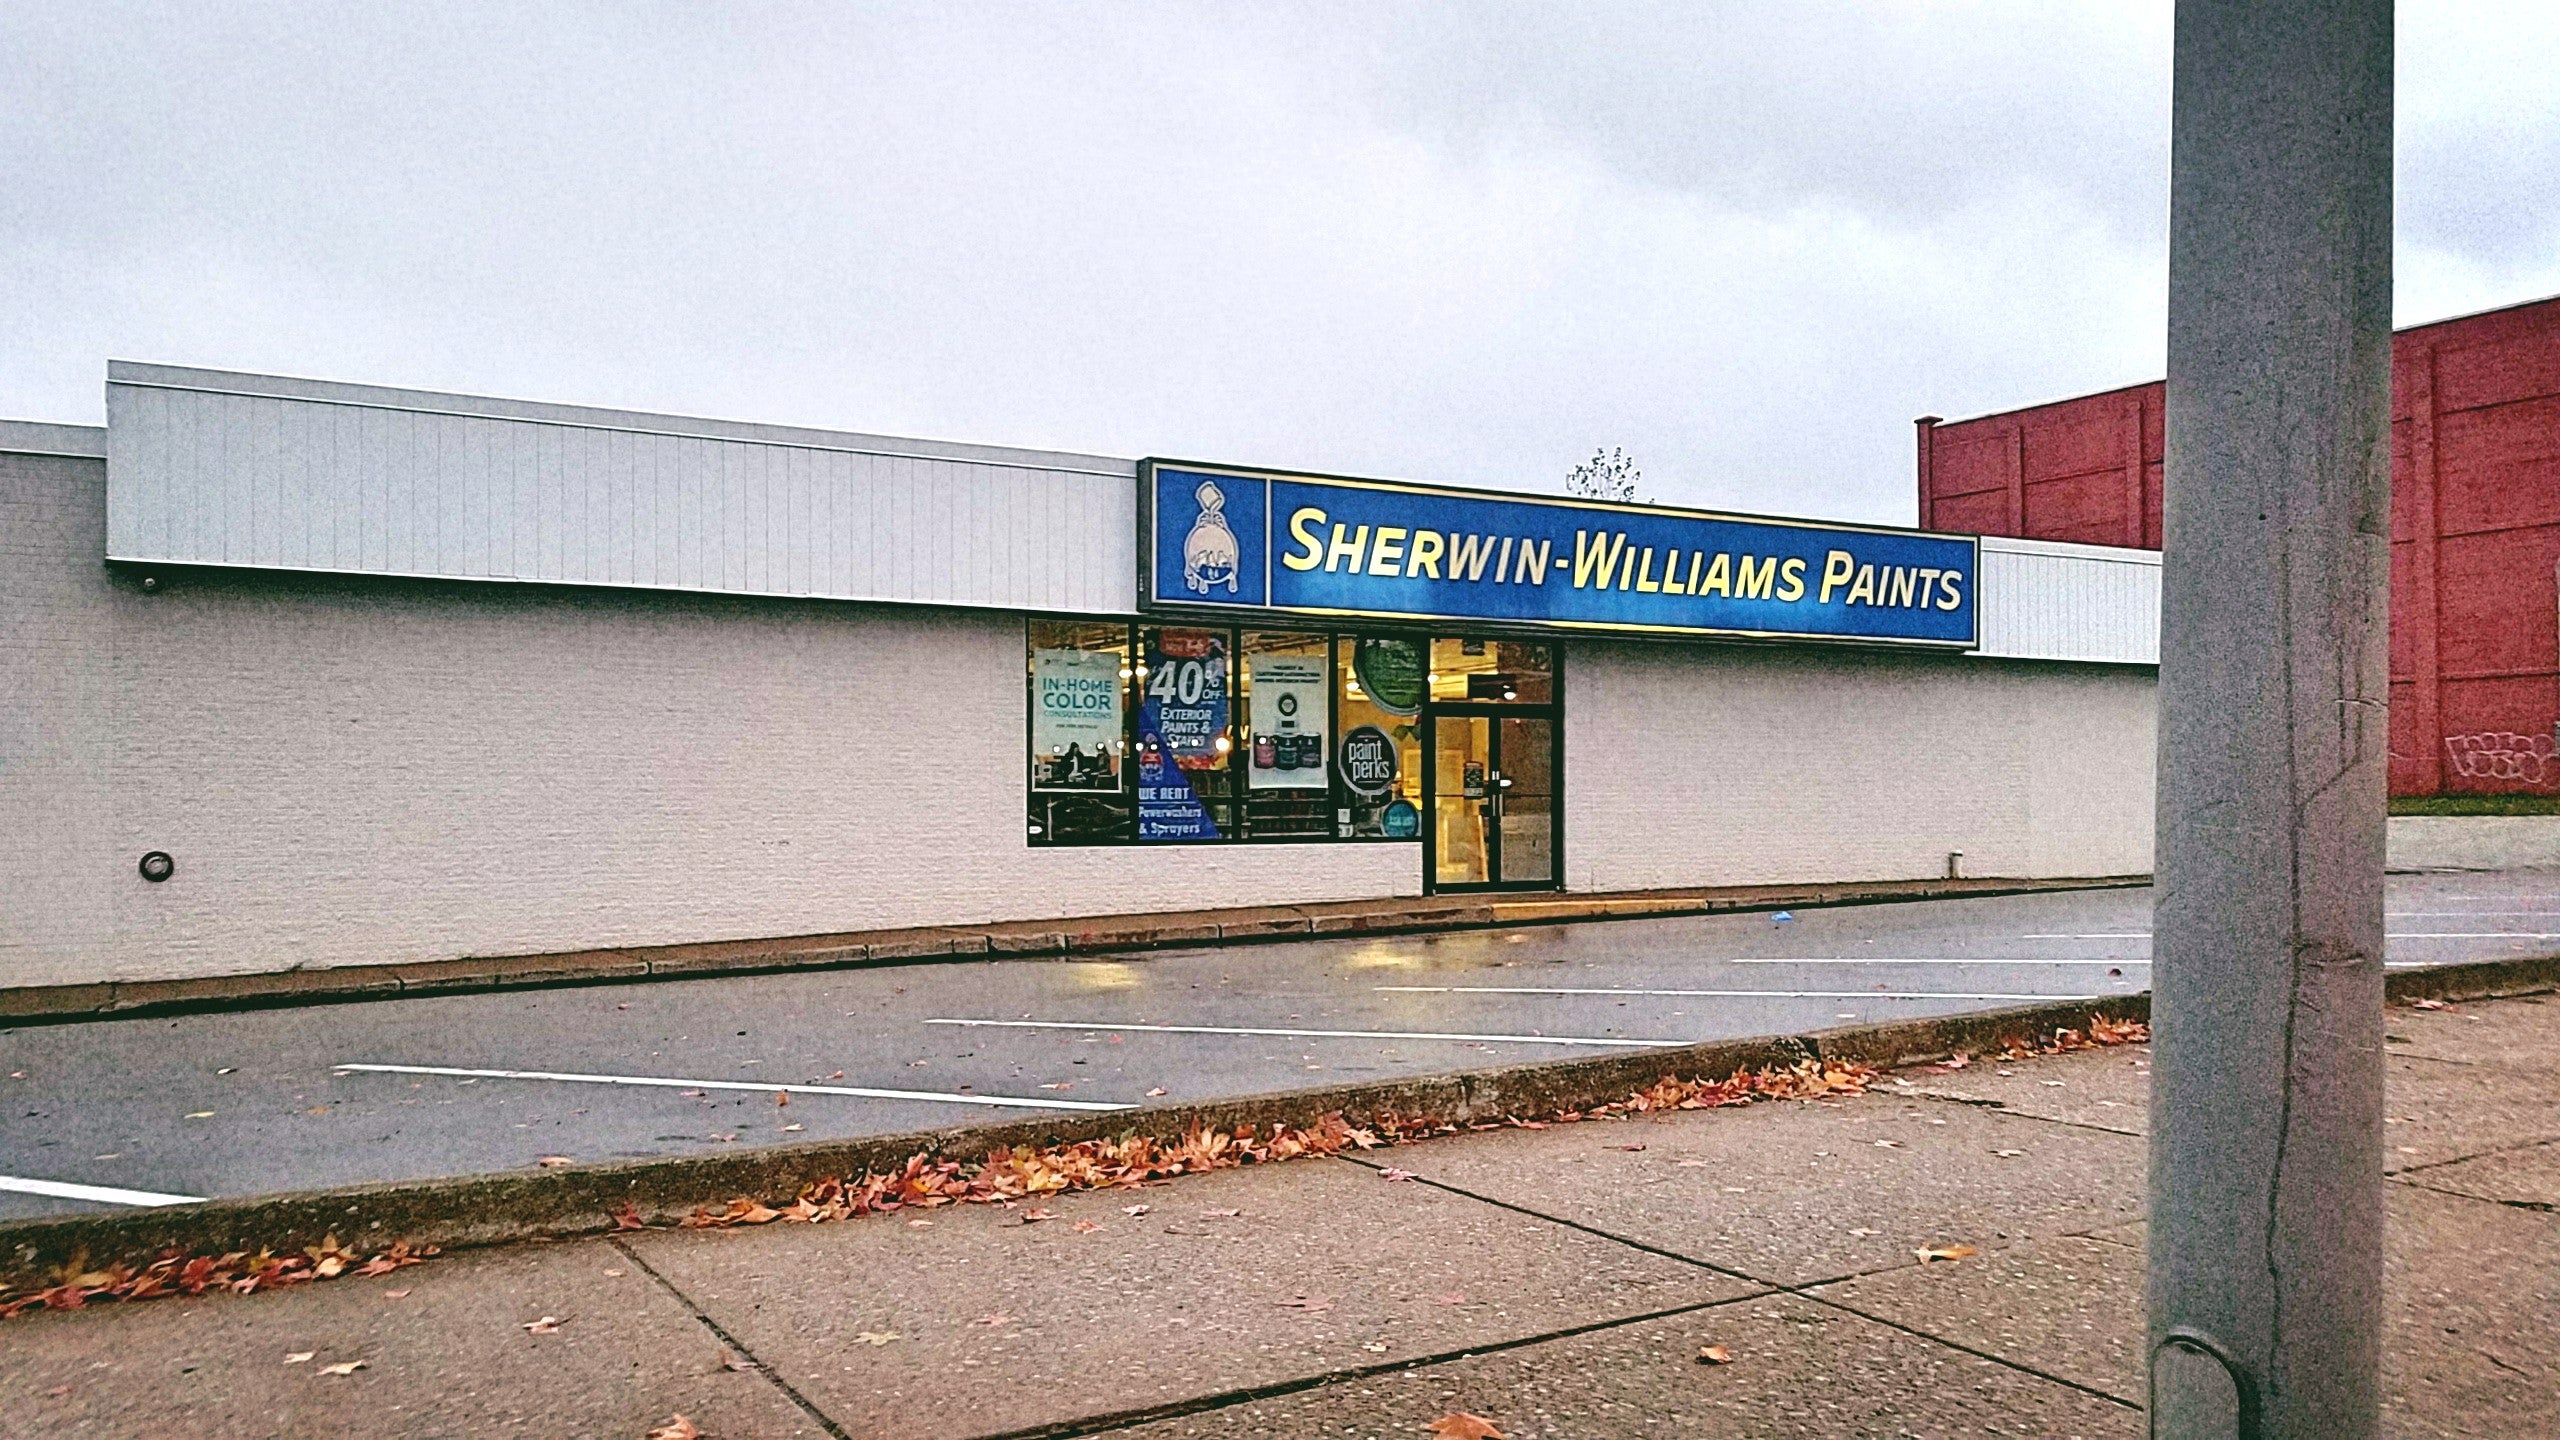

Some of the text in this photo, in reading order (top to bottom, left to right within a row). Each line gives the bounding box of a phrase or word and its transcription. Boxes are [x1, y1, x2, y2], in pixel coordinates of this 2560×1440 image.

[1282, 507, 1963, 611] SHERWIN-WILLIAMS PAINTS
[1042, 677, 1113, 693] IN-HOME
[1043, 692, 1112, 710] COLOR
[1202, 689, 1223, 700] OFF
[1160, 707, 1213, 721] EXTERIOR
[1160, 720, 1211, 734] PAINTS &
[1348, 739, 1382, 764] paint
[1352, 760, 1390, 781] perks
[1138, 787, 1190, 800] WE RENT
[1138, 821, 1200, 837] & Sprayers
